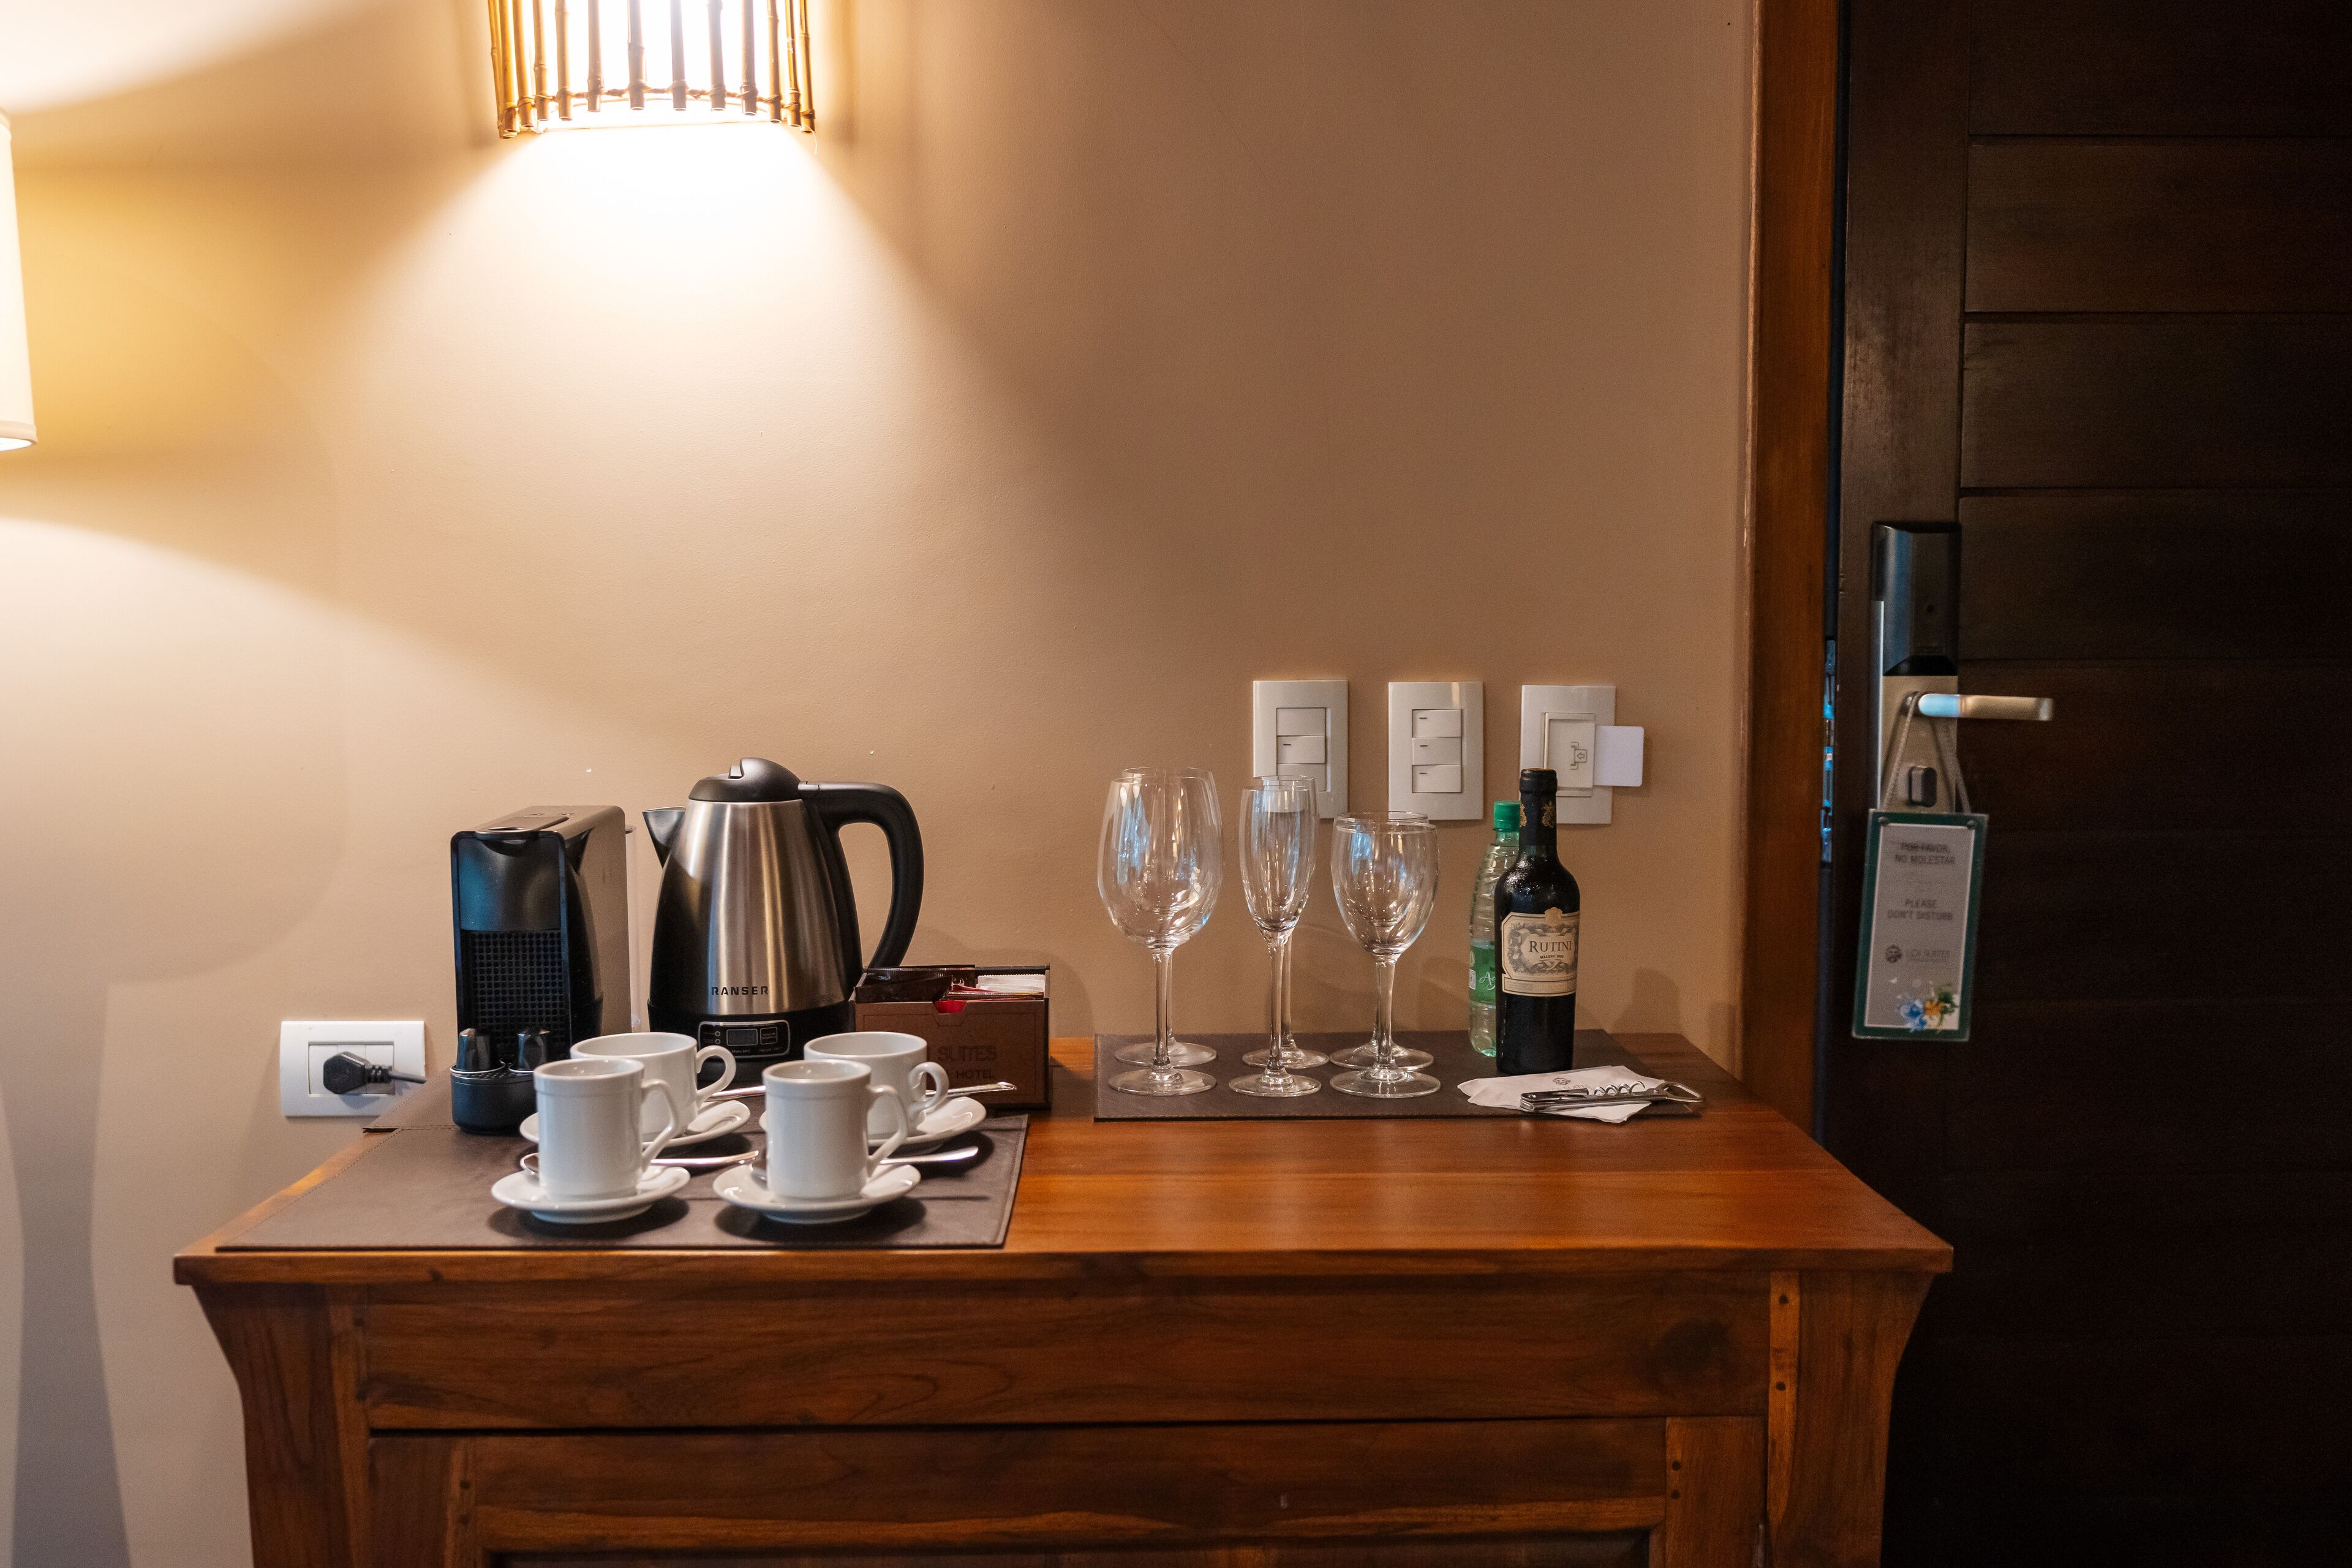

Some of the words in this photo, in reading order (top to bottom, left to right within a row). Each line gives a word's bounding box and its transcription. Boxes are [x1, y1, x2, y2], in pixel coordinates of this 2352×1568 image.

[1910, 855, 1956, 864] MOLESTAR
[1905, 899, 1937, 908] PLEASE
[1916, 911, 1953, 921] DISTURB
[1529, 940, 1572, 953] RUTINI
[712, 986, 769, 995] RANSER
[938, 1045, 997, 1061] SUITES
[956, 1069, 994, 1079] HOTEL
